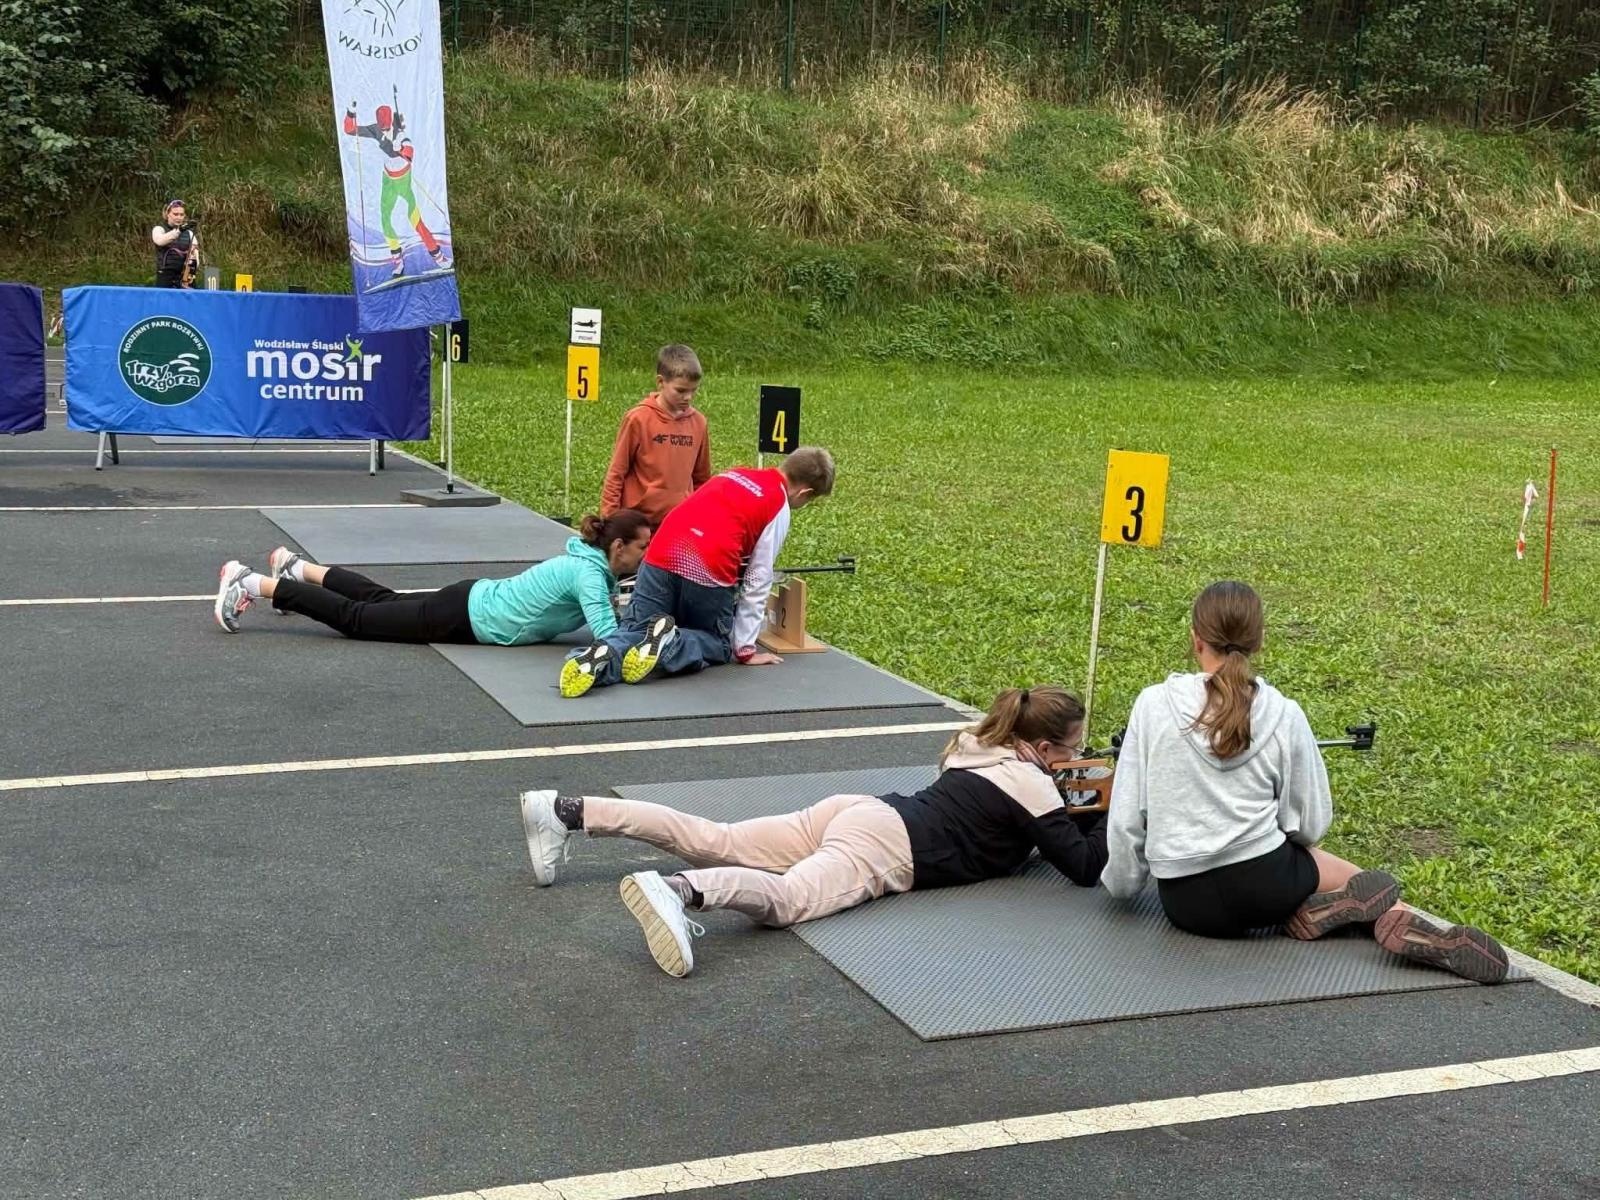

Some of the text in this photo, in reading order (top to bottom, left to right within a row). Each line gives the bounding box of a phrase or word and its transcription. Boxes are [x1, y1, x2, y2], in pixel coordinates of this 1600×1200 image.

[123, 320, 204, 353] RODZINNY PARK ROZRYWKI
[254, 339, 344, 351] Wodzisław Śląski
[451, 334, 461, 361] 6
[125, 360, 169, 381] Trzy
[247, 350, 382, 381] mosir
[260, 383, 364, 401] centrum
[577, 366, 588, 399] 5
[771, 410, 788, 453] 4
[1121, 485, 1145, 543] 3
[781, 607, 787, 629] 2
